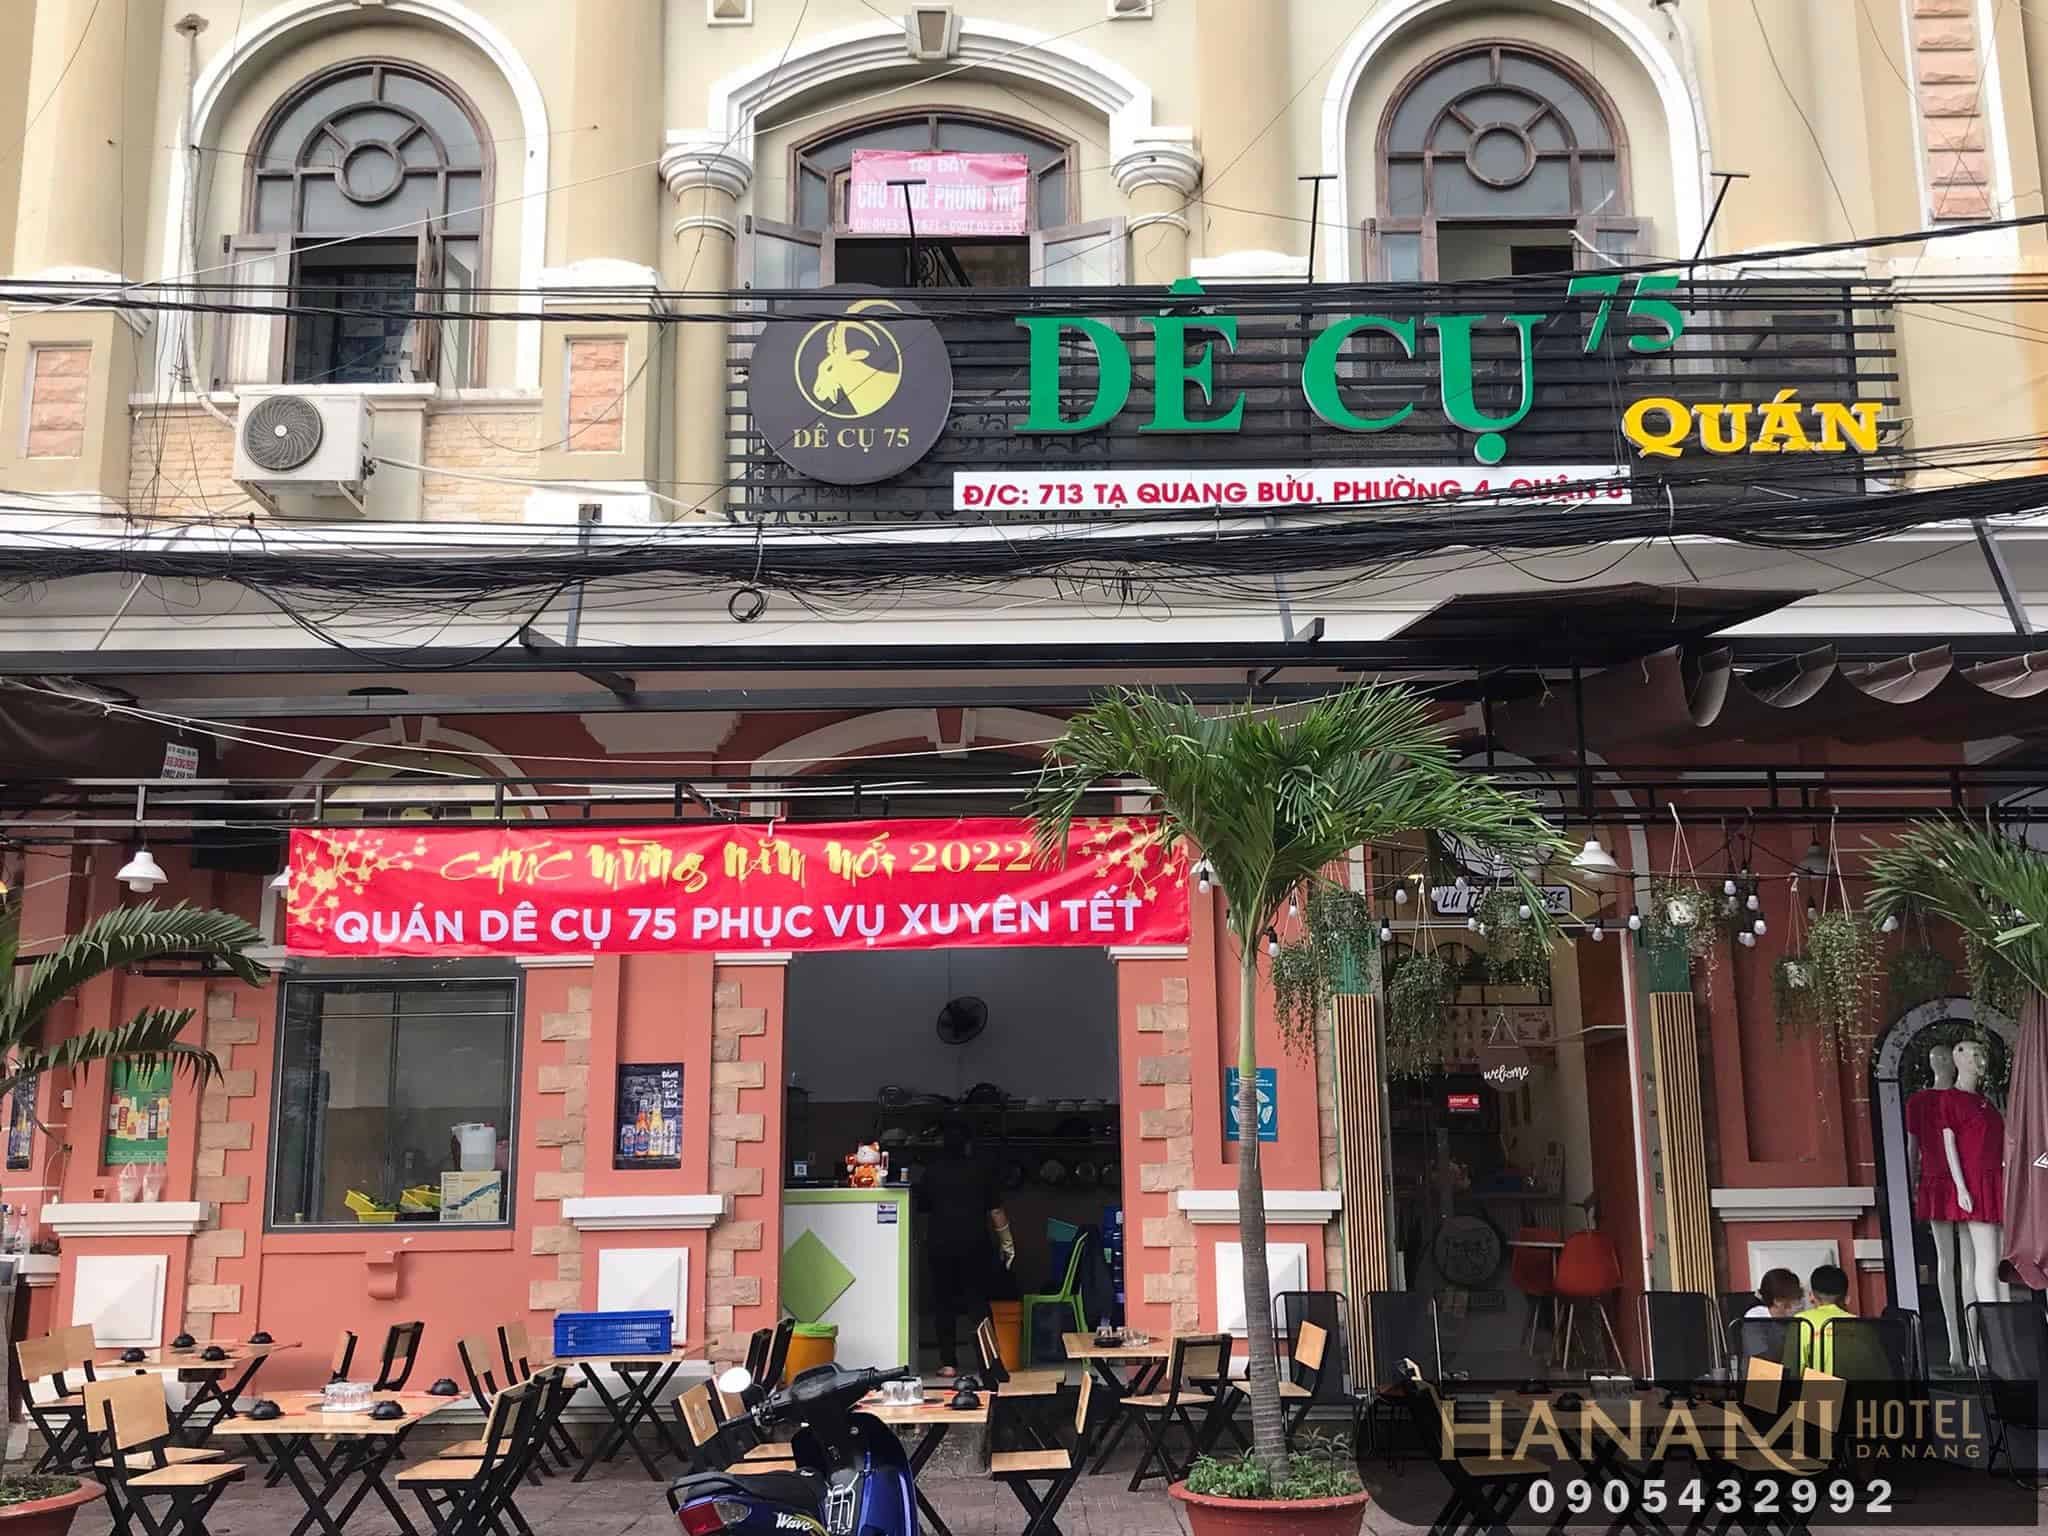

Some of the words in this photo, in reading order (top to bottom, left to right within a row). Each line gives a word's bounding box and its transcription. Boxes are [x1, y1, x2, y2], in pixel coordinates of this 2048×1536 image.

[857, 182, 888, 209] CHO
[1566, 275, 1684, 353] 75
[1014, 277, 1245, 434] DÊ
[1302, 314, 1547, 465] CỤ
[793, 422, 830, 449] DÊ
[836, 427, 876, 453] CỤ
[883, 427, 911, 448] 75
[1622, 388, 1883, 458] QUÁN
[962, 484, 1029, 506] Đ/C:
[1038, 484, 1083, 504] 713
[1094, 483, 1128, 508] TẠ
[1136, 482, 1248, 504] QUANG
[1256, 474, 1323, 505] BỬU,
[1333, 474, 1462, 504] PHƯỜNG
[908, 840, 1033, 873] 2022
[335, 902, 464, 944] QUÁN
[480, 901, 538, 943] DÊ
[551, 908, 611, 950] CỤ
[628, 907, 676, 942] 75
[692, 905, 813, 948] PHỤC
[823, 903, 884, 945] VỤ
[899, 895, 1049, 936] XUYÊN
[1060, 884, 1143, 933] TẾT
[1483, 1064, 1530, 1083] welcome
[773, 1512, 814, 1532] Wave
